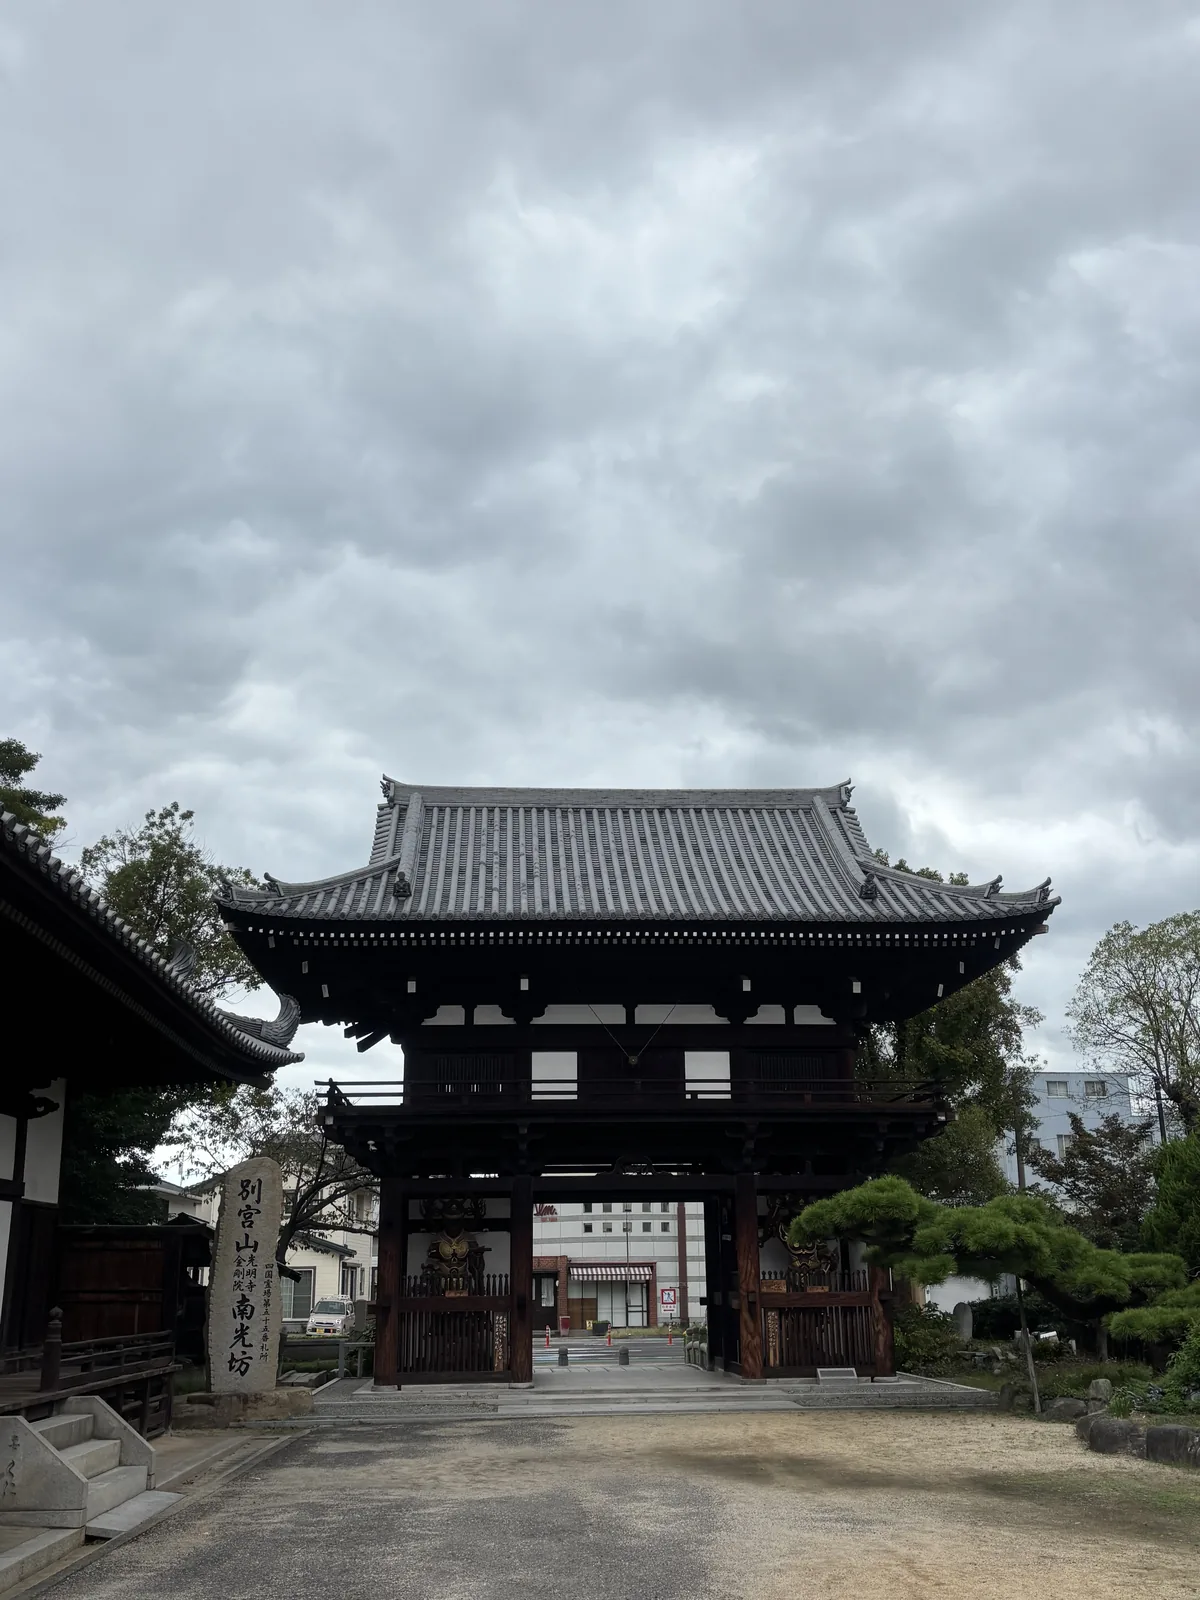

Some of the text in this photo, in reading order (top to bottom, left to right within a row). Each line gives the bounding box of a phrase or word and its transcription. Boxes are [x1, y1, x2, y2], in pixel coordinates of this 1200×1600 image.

[235, 1178, 262, 1253] 別宮山
[245, 1254, 258, 1292] 光明寺
[227, 1293, 255, 1377] 南光坊
